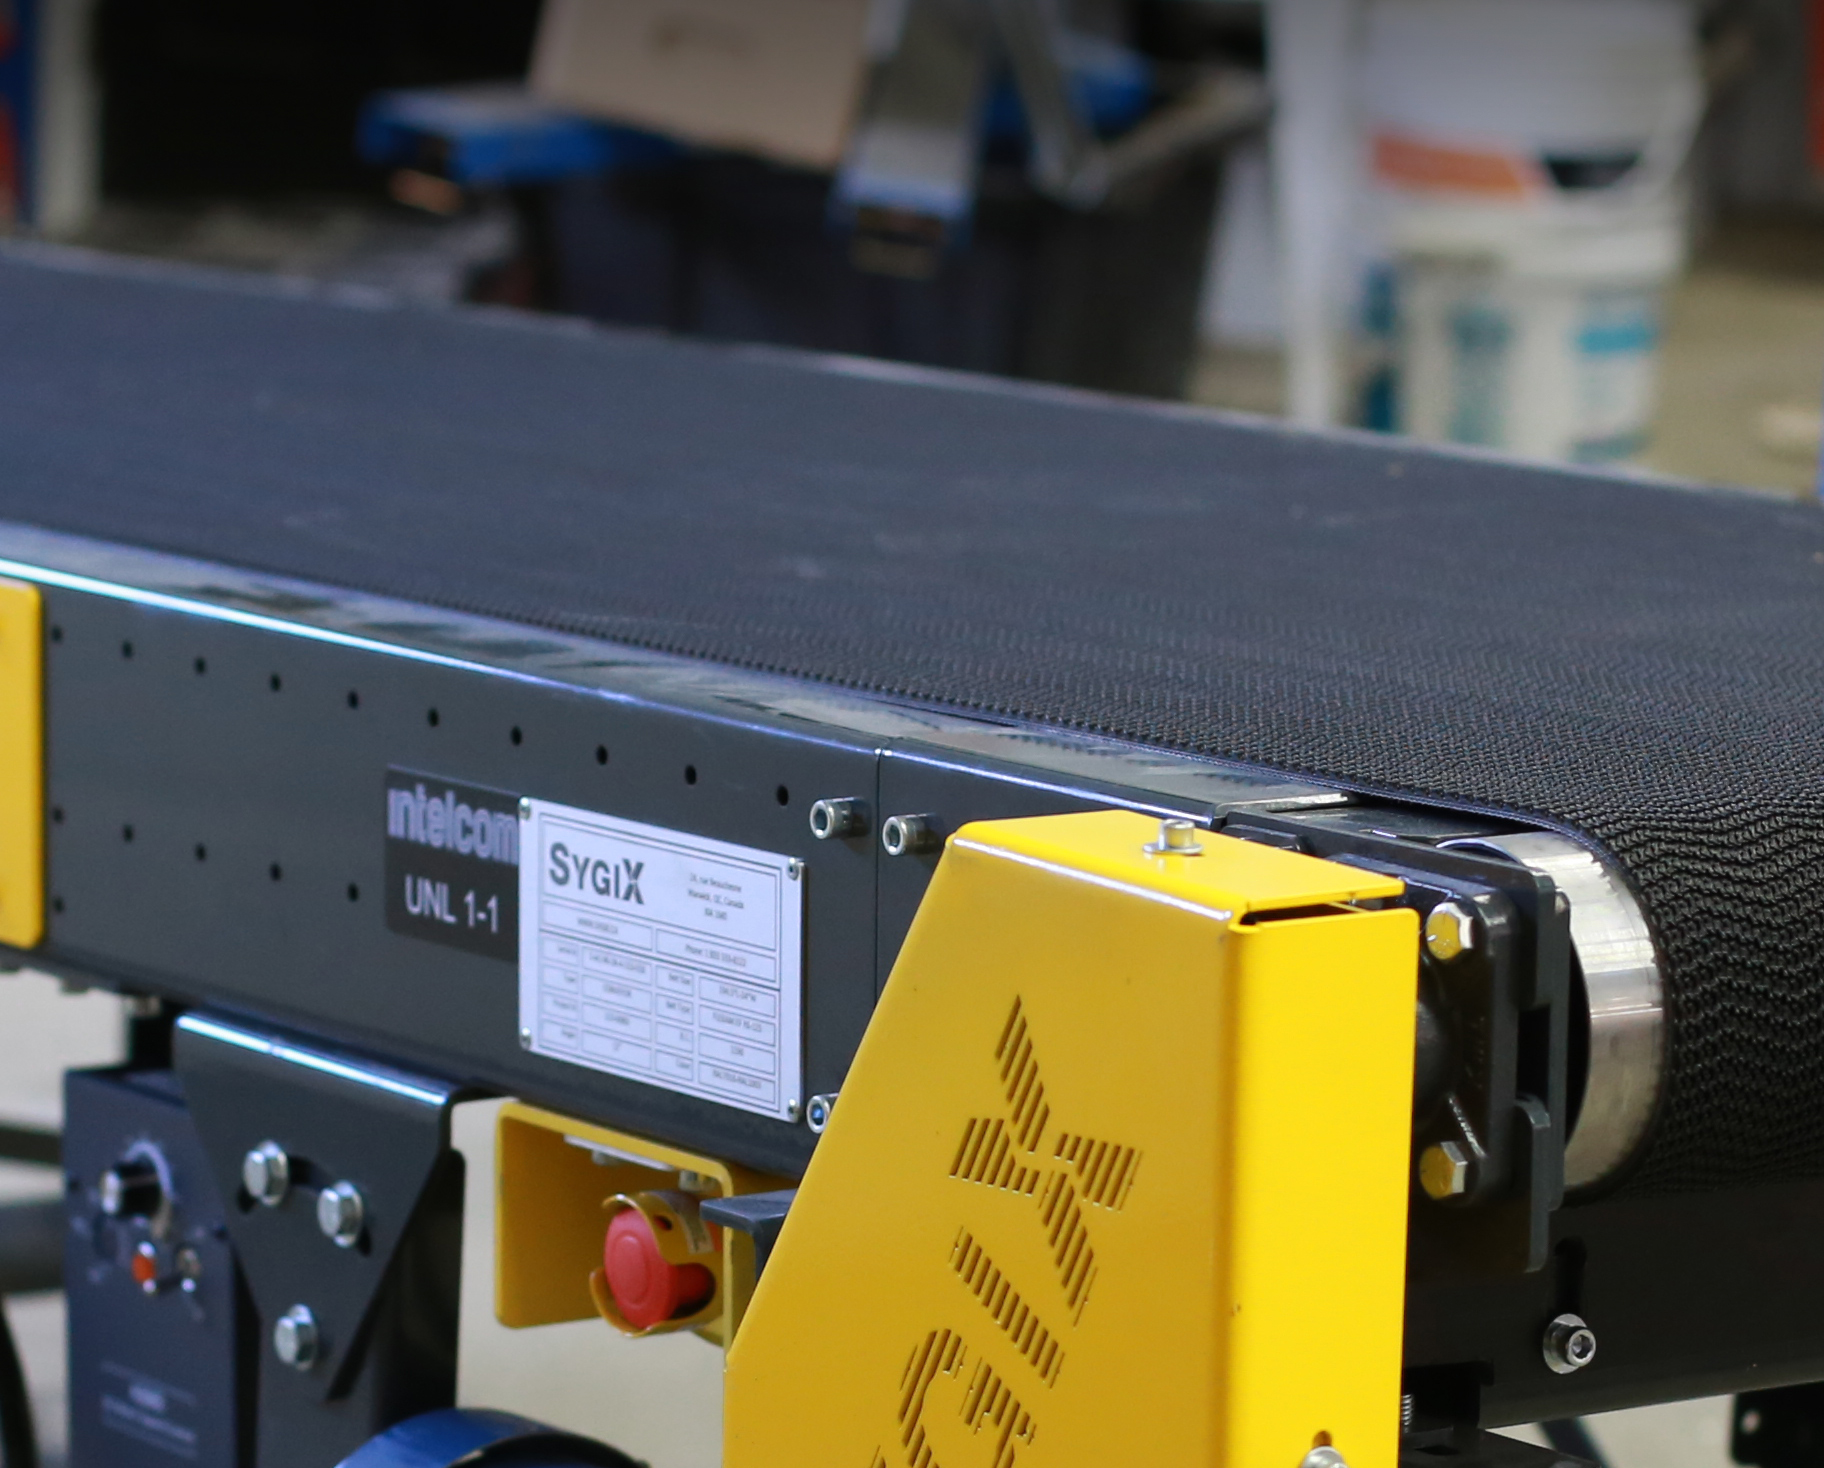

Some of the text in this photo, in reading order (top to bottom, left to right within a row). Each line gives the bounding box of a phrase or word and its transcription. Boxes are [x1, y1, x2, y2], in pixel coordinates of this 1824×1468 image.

[387, 783, 519, 866] intelcom
[404, 873, 499, 934] UNL 1-1
[548, 841, 645, 906] SYGIX
